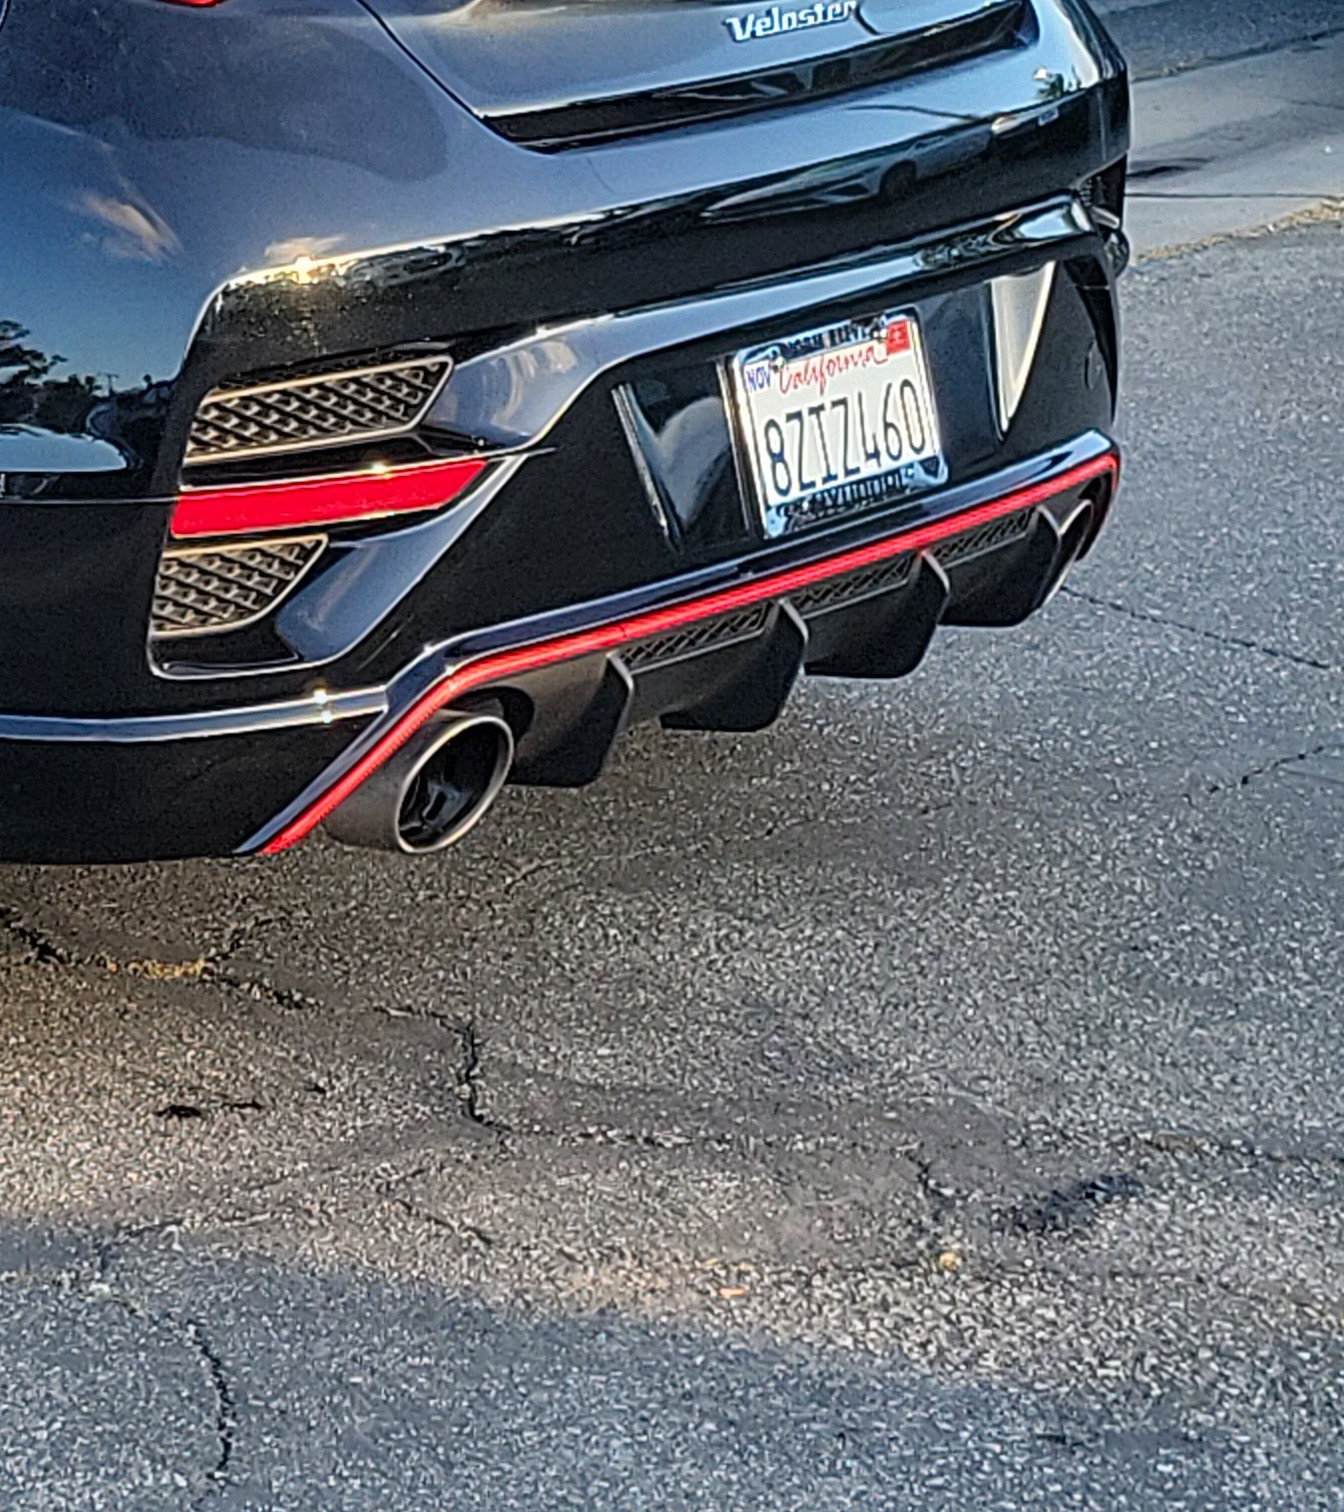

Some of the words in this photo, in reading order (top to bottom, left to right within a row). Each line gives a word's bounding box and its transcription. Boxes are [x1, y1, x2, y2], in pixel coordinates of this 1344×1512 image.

[724, 0, 857, 42] Veloster
[745, 364, 772, 393] NOV
[777, 344, 889, 398] California
